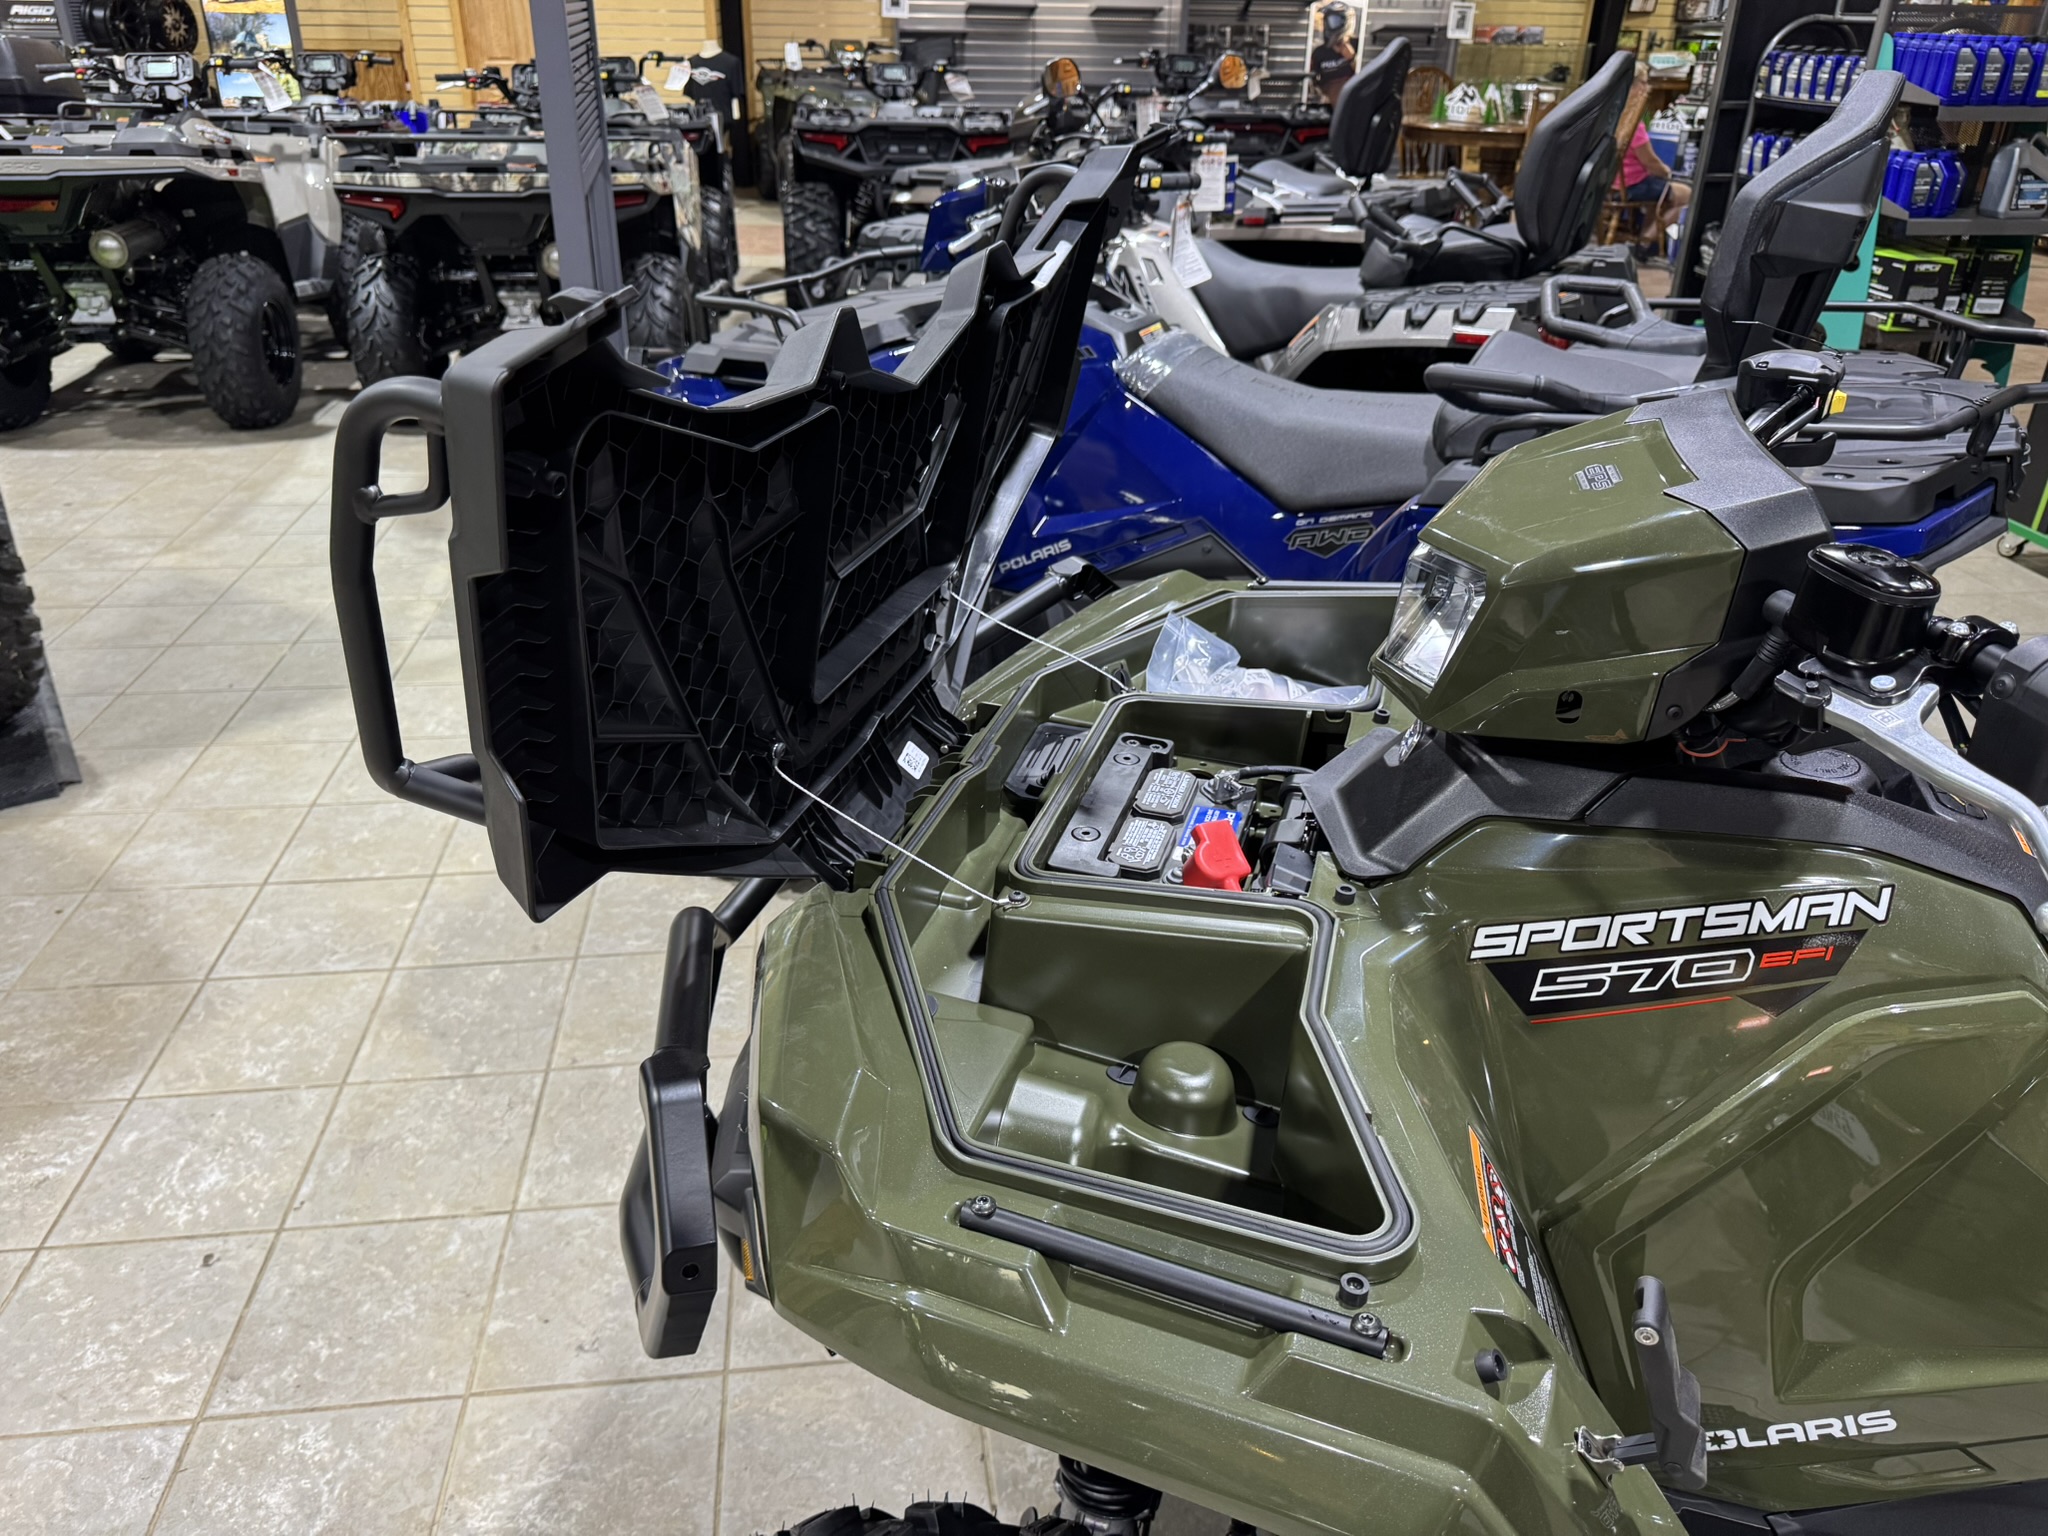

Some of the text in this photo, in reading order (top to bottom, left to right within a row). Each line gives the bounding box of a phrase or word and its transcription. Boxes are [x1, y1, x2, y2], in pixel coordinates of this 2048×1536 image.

[10, 5, 56, 15] RIGID
[999, 539, 1072, 574] POLARIS
[1288, 525, 1371, 551] AWD
[1469, 885, 1894, 960] SPORTSMAN
[1530, 946, 1833, 1001] 570 EFI
[1705, 1409, 1897, 1451] OLARIS
